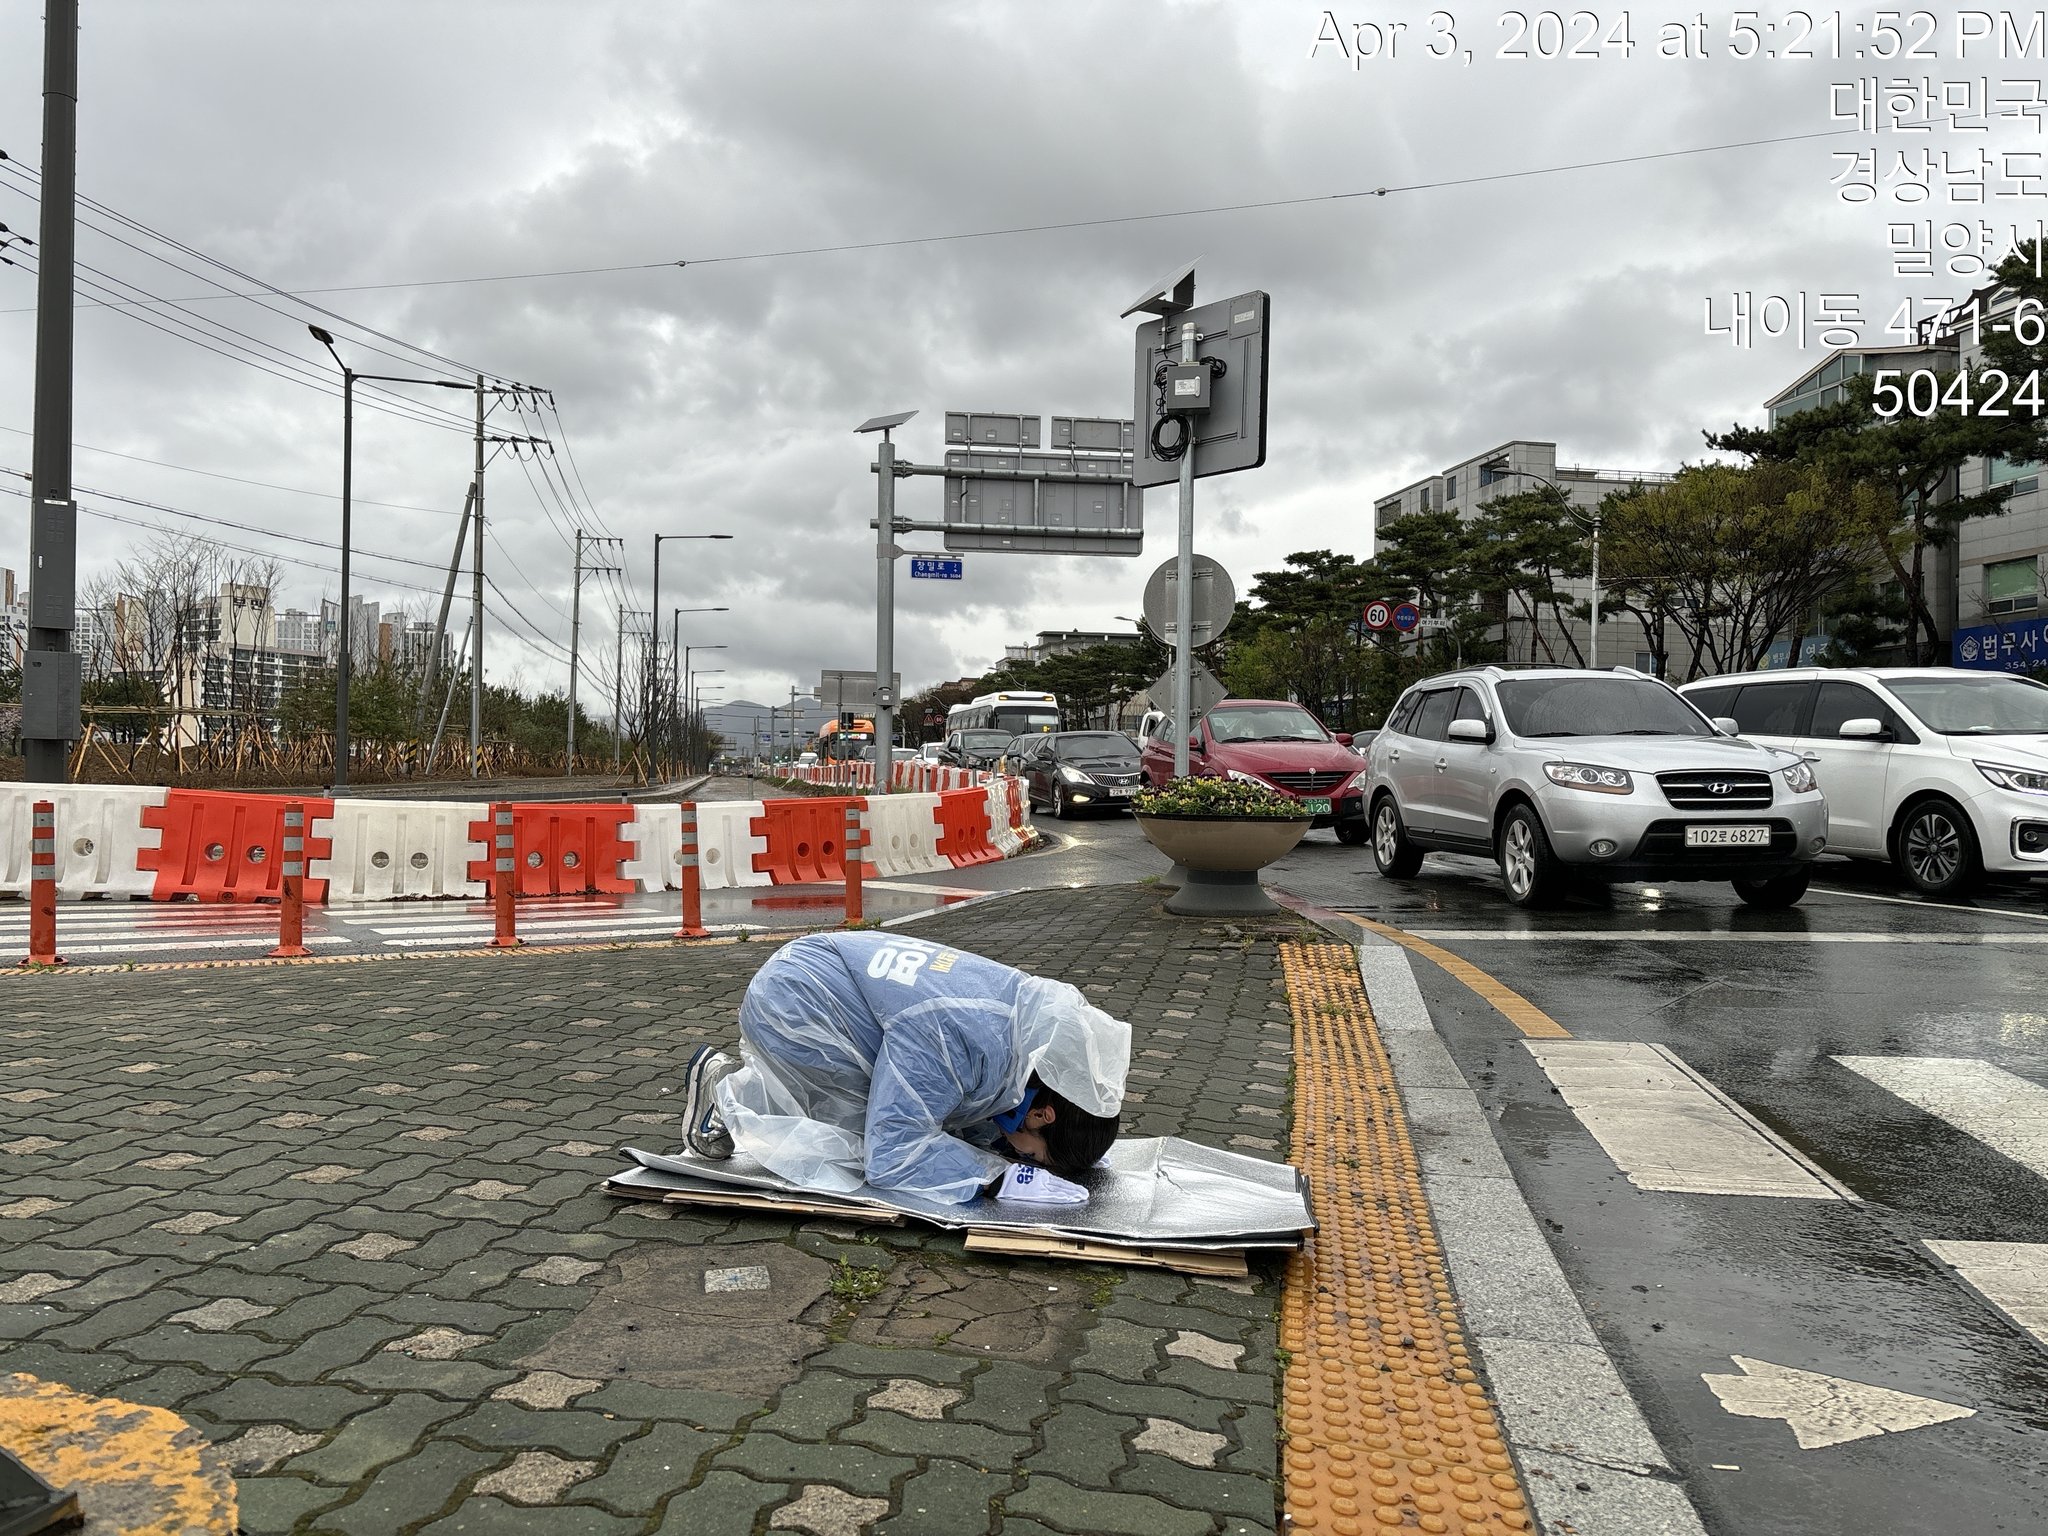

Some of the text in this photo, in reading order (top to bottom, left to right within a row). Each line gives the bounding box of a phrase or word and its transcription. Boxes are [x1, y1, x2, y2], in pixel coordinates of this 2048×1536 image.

[917, 561, 946, 572] 창밀로
[1370, 609, 1385, 622] 60
[1982, 630, 2039, 661] 법무사
[1692, 829, 1765, 843] 102로 6827
